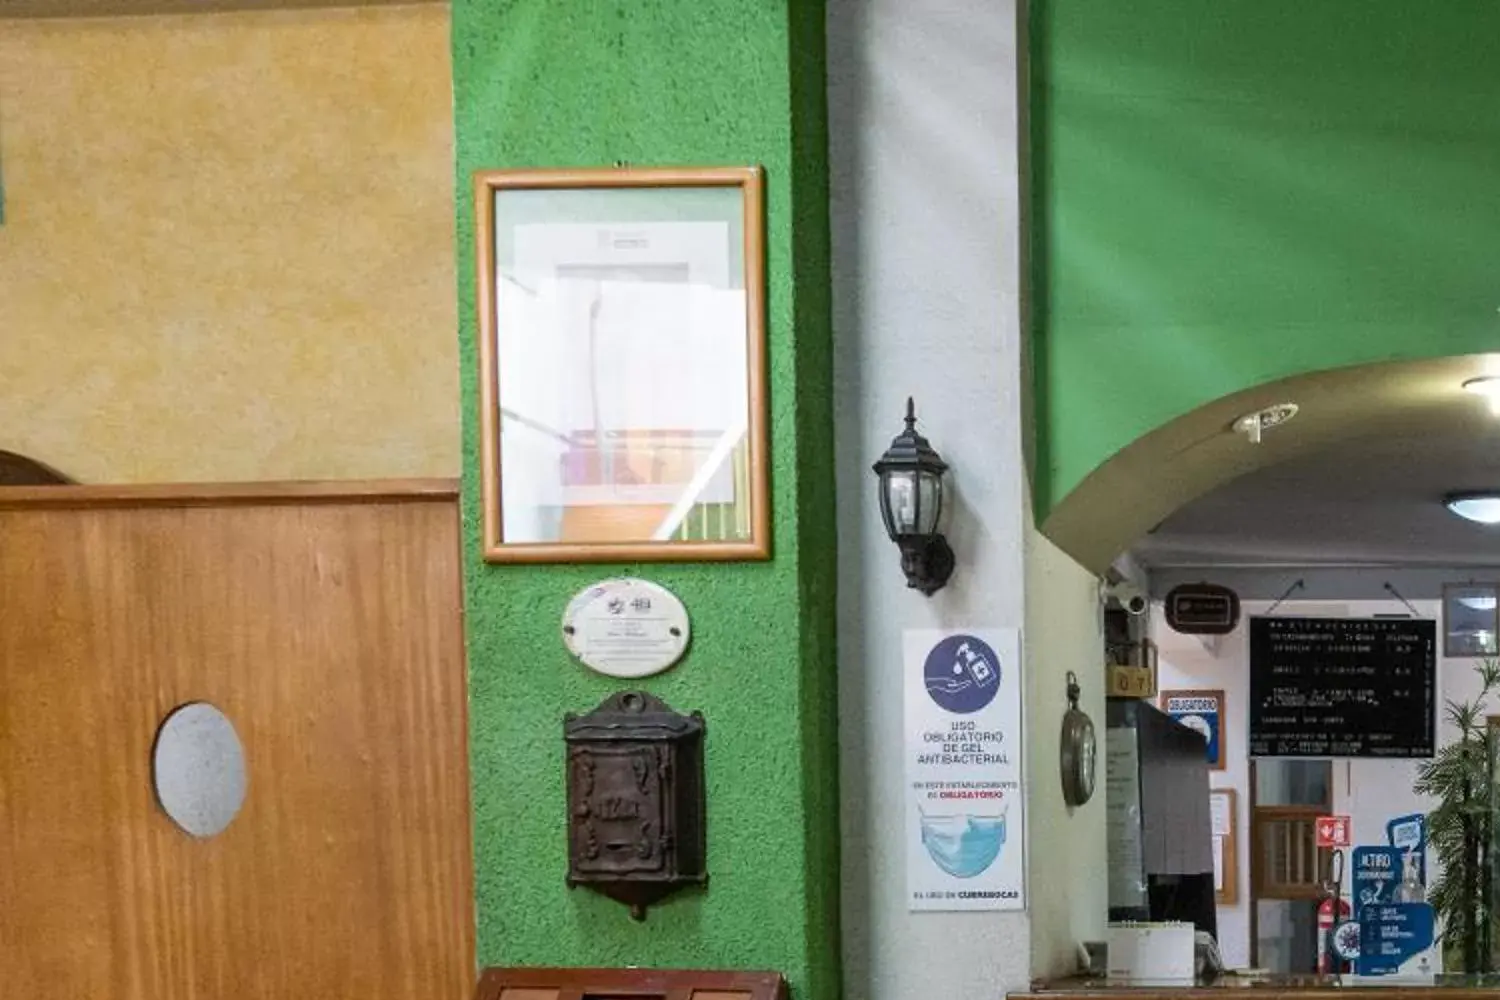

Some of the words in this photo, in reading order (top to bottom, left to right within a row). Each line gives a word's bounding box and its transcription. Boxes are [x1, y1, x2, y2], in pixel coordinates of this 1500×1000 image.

[951, 721, 976, 731] USO
[923, 731, 1004, 743] OBLIGATORIO
[943, 743, 959, 753] DE
[961, 743, 985, 753] GEL
[917, 753, 1009, 765] ANTIBACTERIAL
